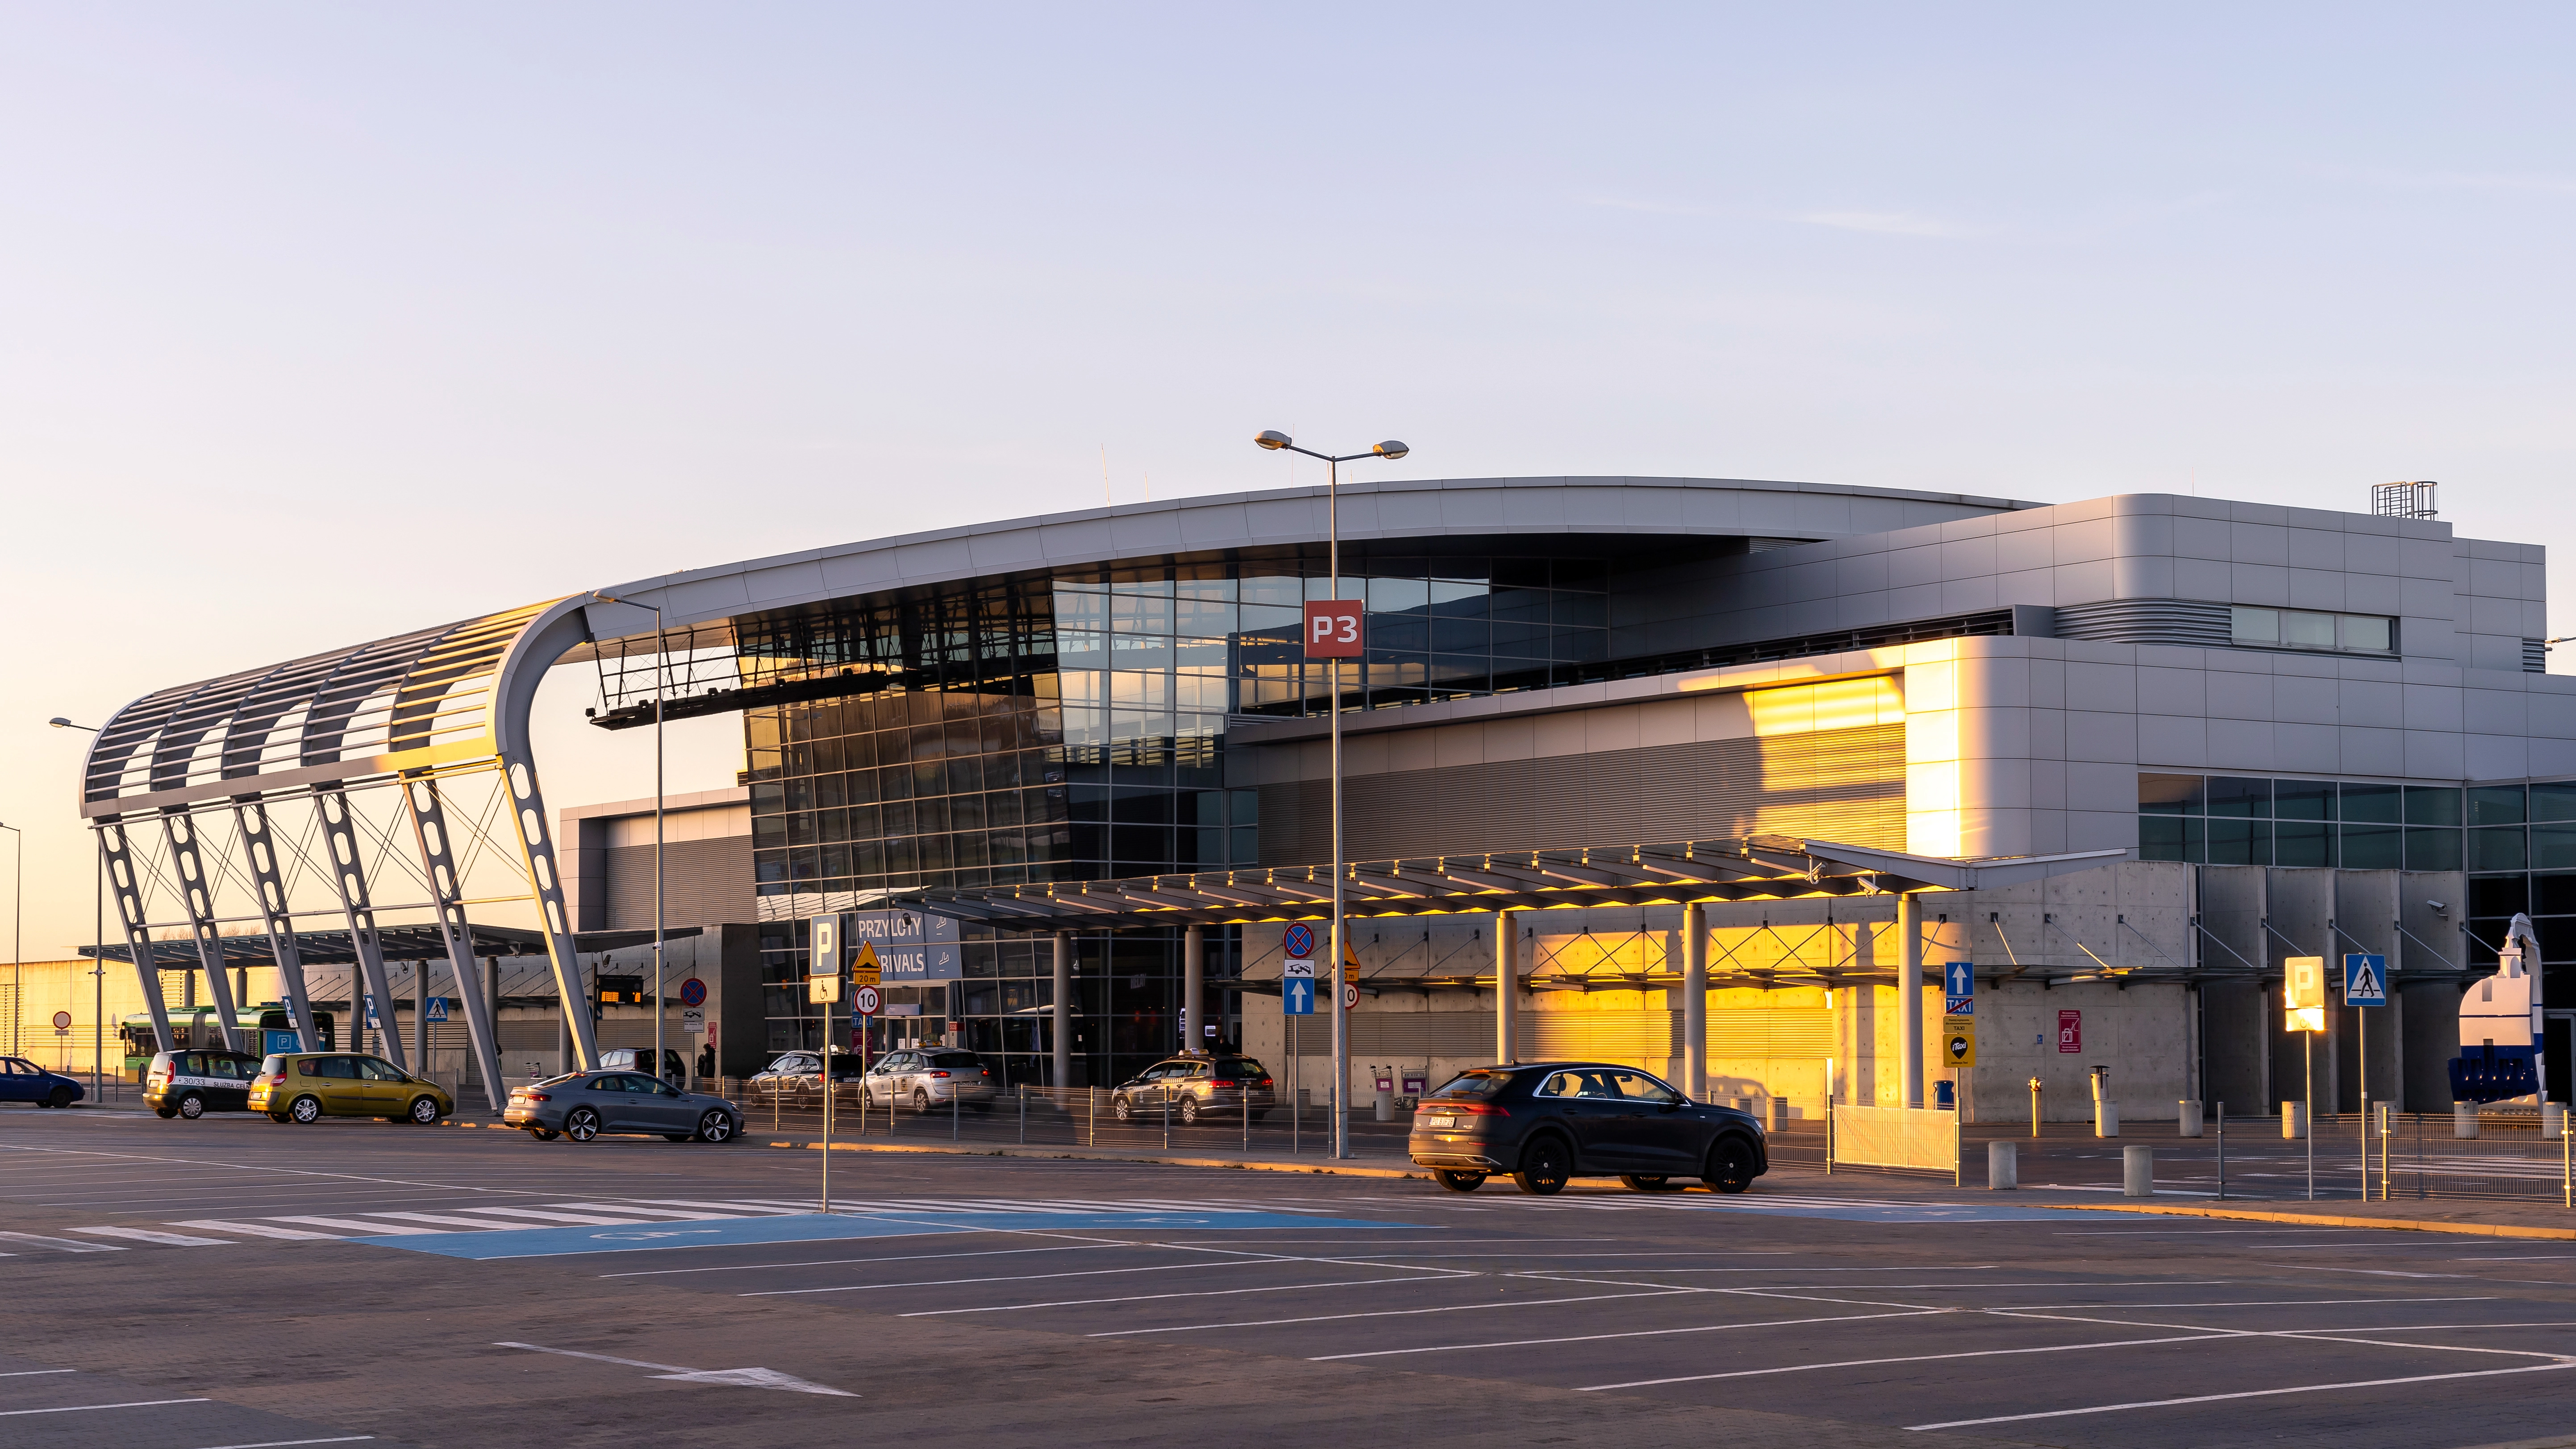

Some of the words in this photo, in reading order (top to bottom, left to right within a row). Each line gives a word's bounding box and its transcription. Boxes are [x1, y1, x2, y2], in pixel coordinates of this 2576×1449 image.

[1313, 616, 1357, 643] P3
[817, 923, 832, 966] P
[876, 954, 924, 972] RIVALS
[2295, 965, 2314, 1000] P
[860, 993, 875, 1008] 10
[1347, 989, 1355, 1002] 0
[284, 999, 291, 1015] P
[367, 998, 374, 1014] P
[1947, 1000, 1971, 1012] TAXI
[281, 1038, 287, 1046] P
[1952, 1042, 1967, 1051] iTaxi
